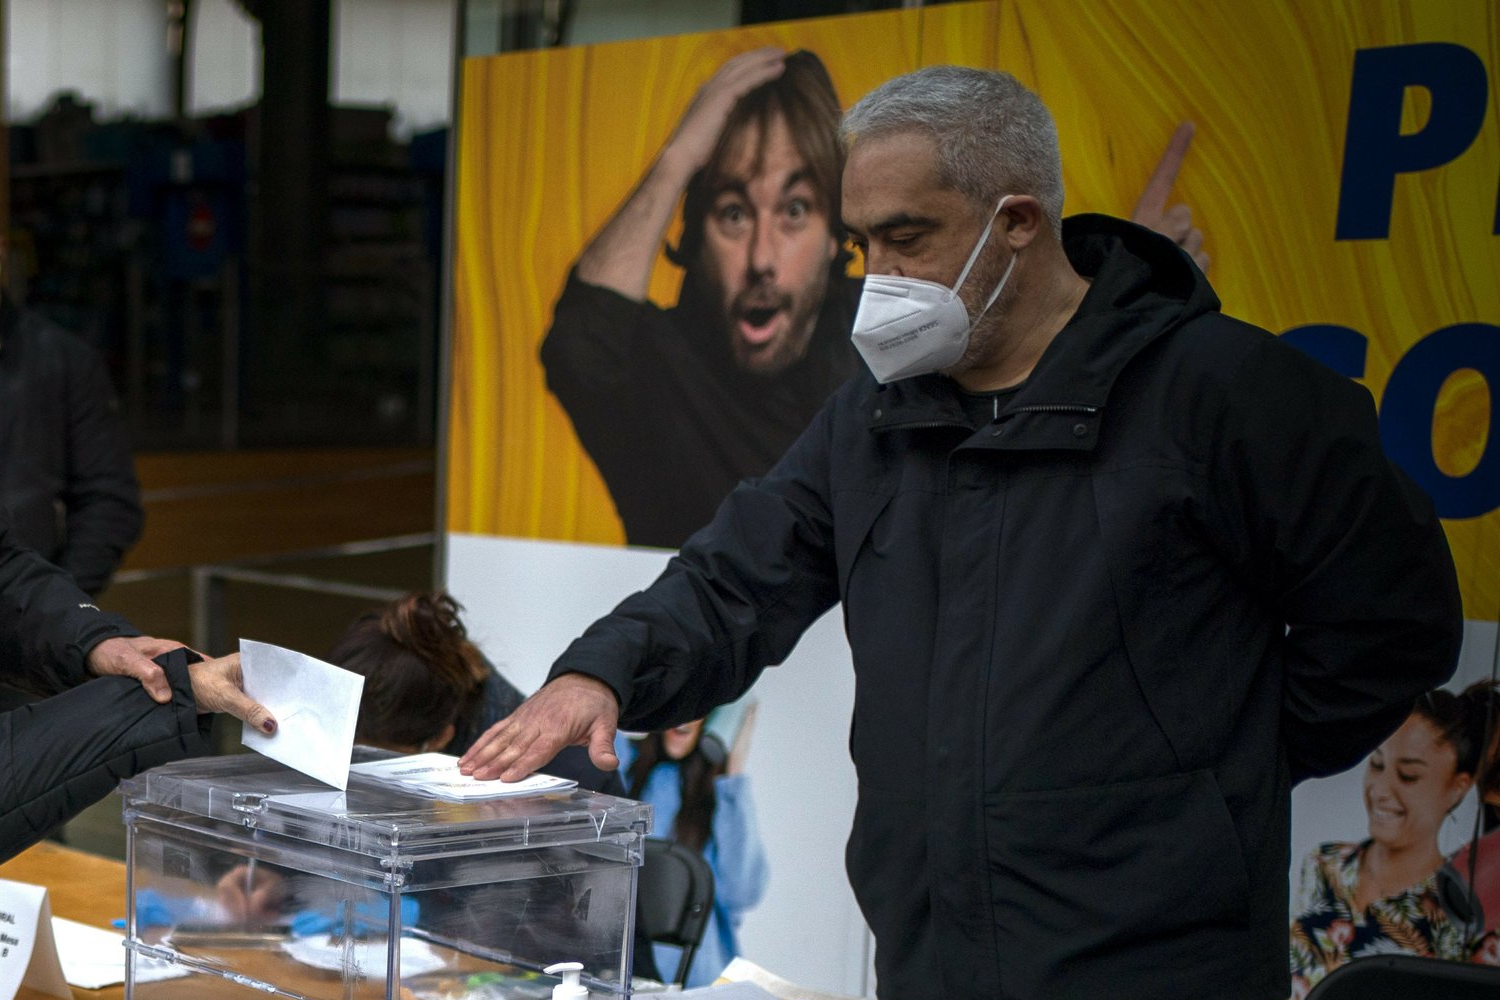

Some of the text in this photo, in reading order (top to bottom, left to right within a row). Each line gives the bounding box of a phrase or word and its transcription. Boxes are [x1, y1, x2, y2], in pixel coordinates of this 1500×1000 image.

[1334, 41, 1500, 241] P
[1277, 322, 1500, 521] O
[0, 933, 19, 946] Mesa
